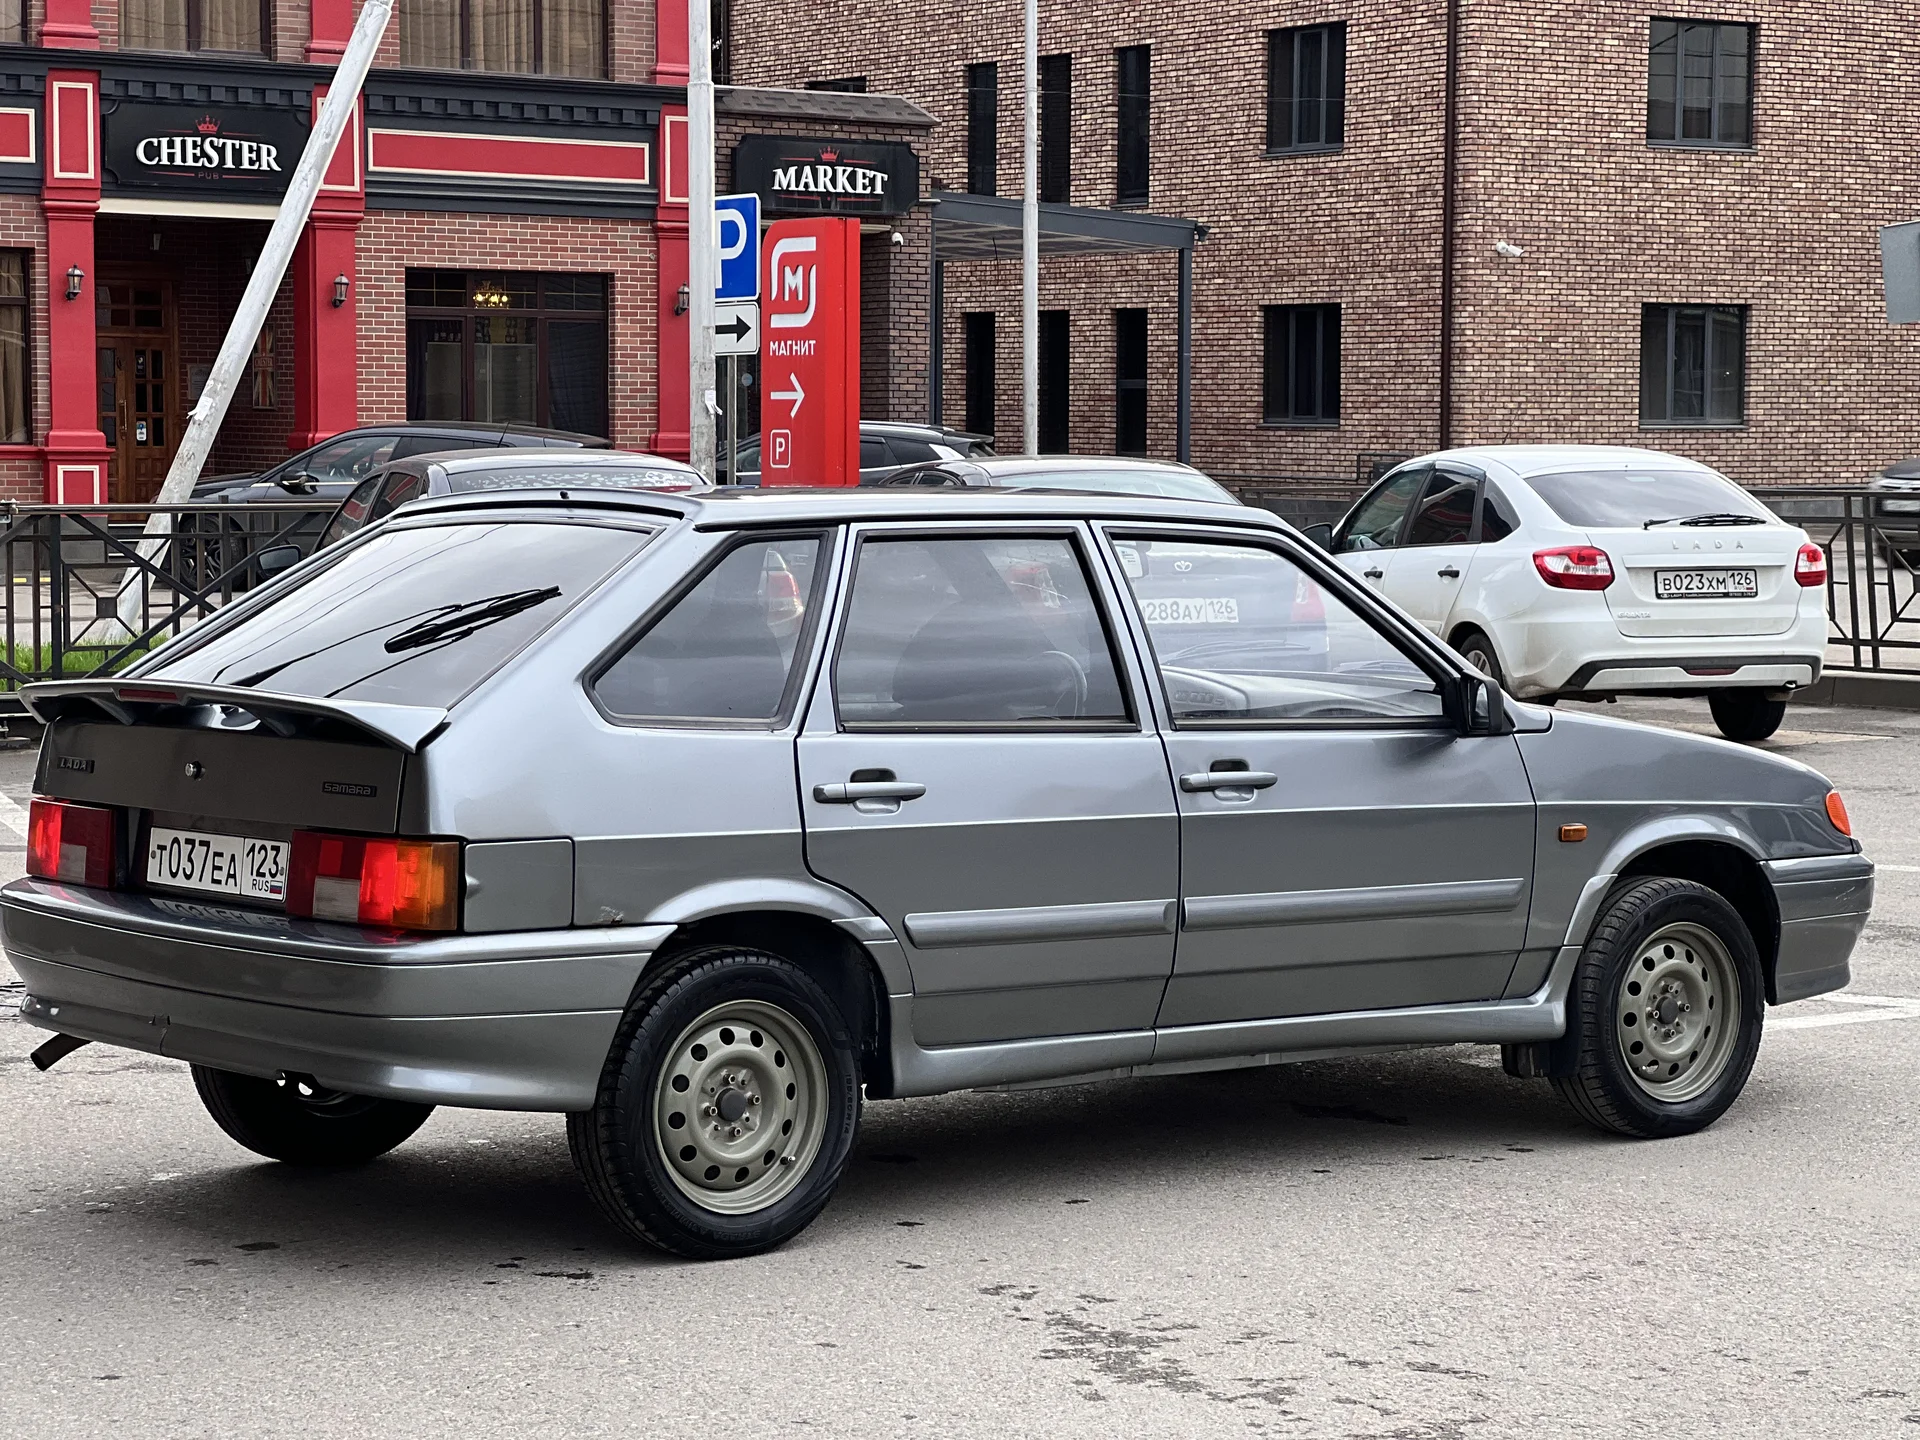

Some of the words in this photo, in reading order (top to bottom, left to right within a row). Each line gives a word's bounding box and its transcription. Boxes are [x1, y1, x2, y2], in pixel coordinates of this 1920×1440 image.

[135, 136, 282, 172] CHESTER
[198, 172, 219, 180] PUB
[771, 165, 888, 195] MARKET
[715, 208, 748, 289] P
[769, 339, 817, 356] МАГНИТ
[775, 437, 786, 460] P
[1671, 539, 1744, 550] LADA
[1662, 573, 1727, 591] В023ХМ
[1729, 572, 1752, 586] 126
[1208, 599, 1233, 614] 126
[60, 758, 87, 770] LADA
[156, 836, 238, 887] Т037ЕА
[246, 843, 281, 879] 123
[251, 878, 270, 892] RUS
